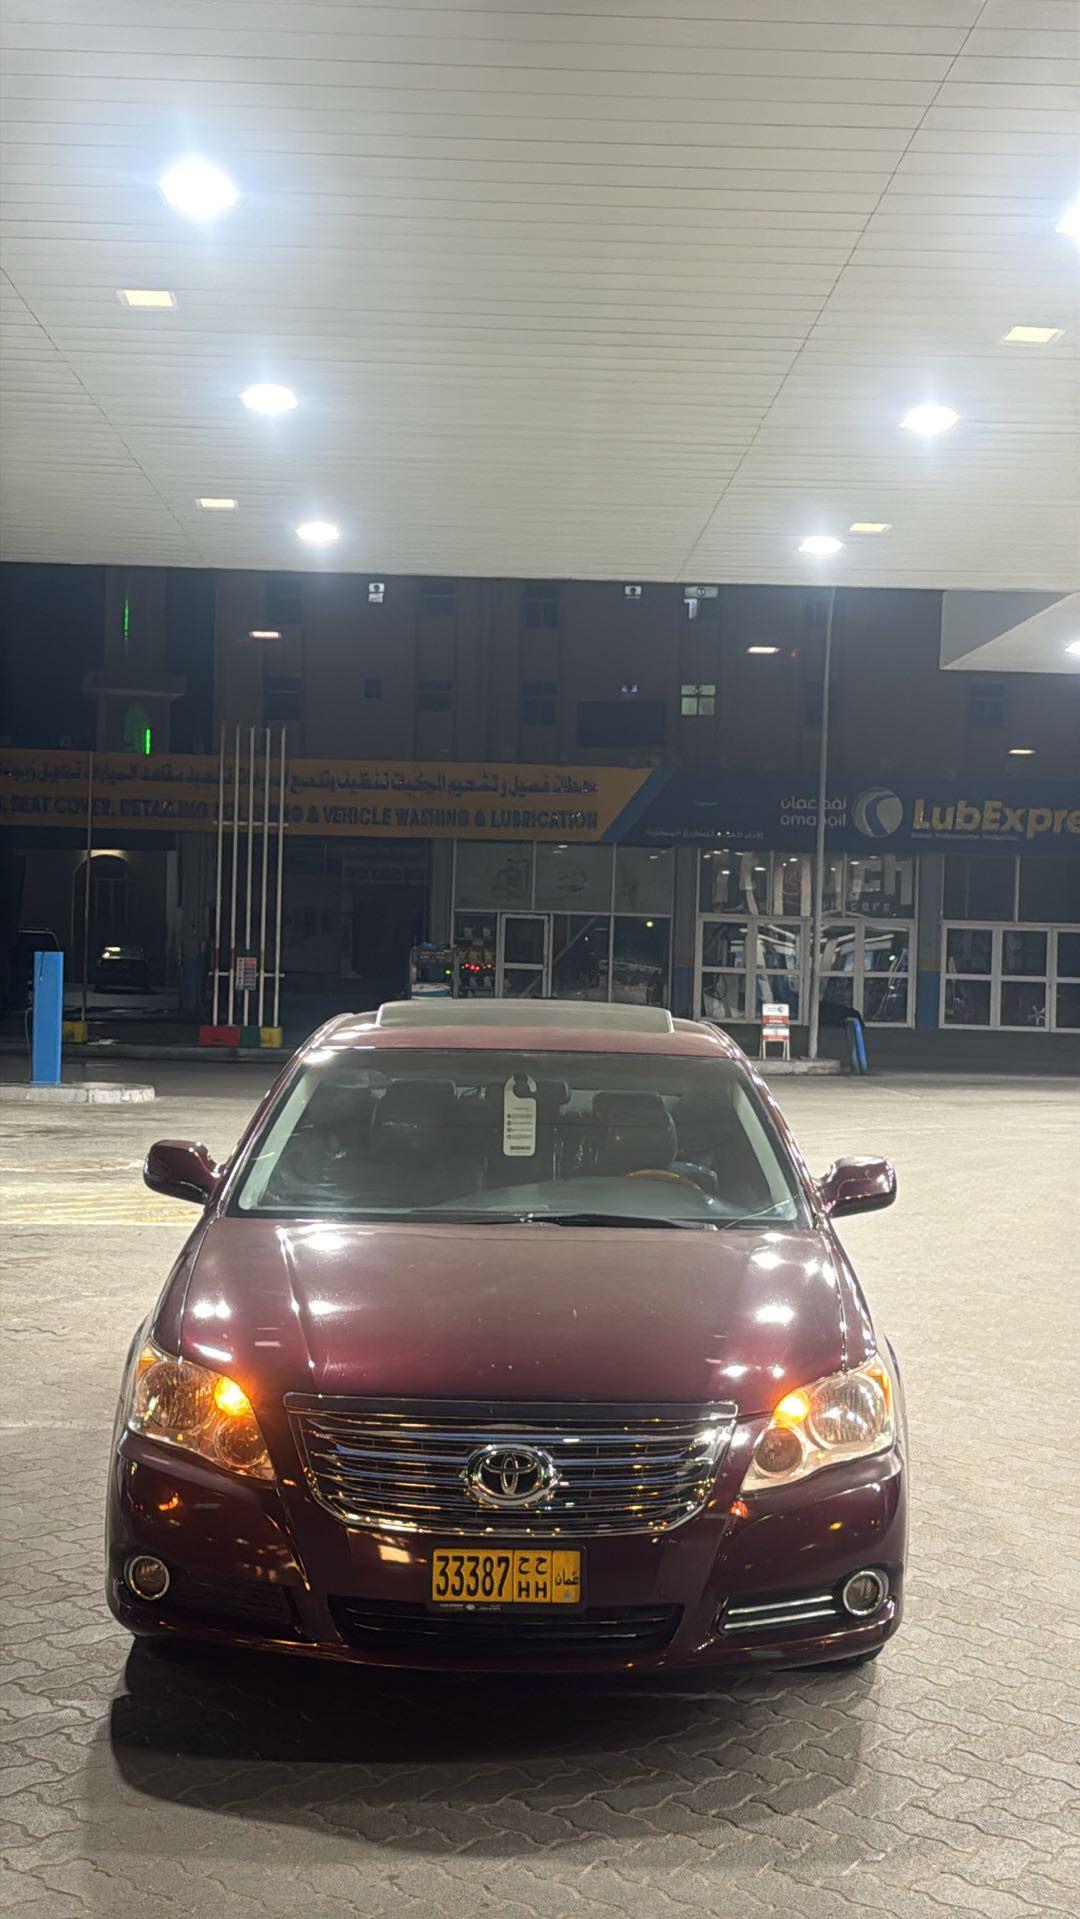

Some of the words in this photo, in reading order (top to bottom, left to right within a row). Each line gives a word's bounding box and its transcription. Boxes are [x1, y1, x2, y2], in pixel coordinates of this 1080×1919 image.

[323, 806, 392, 826] VEHICLE
[395, 807, 469, 827] WASHING
[490, 809, 599, 829] LUBRICATION
[780, 813, 846, 827] omaoil
[436, 1555, 510, 1598] 33387
